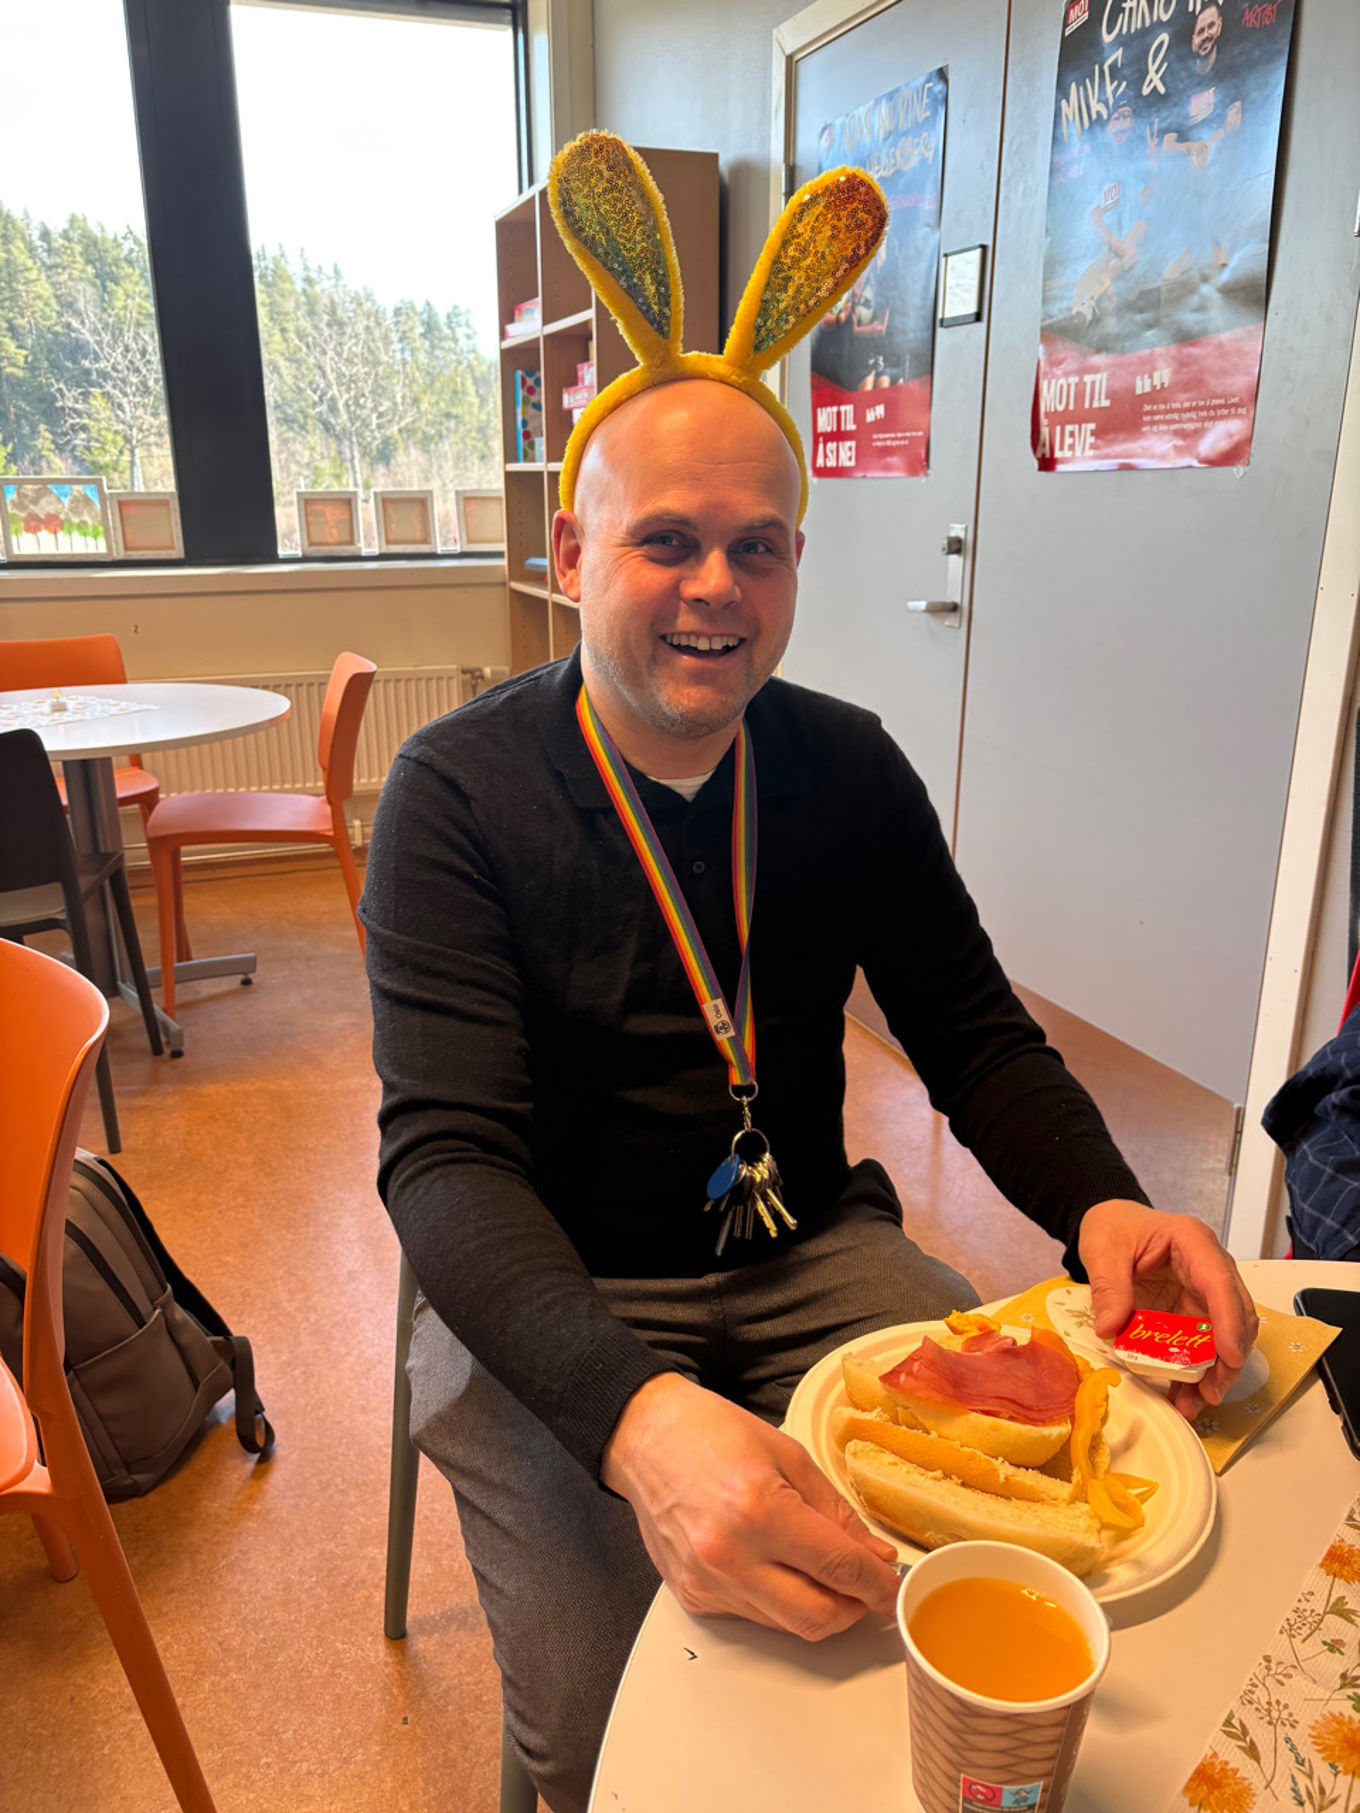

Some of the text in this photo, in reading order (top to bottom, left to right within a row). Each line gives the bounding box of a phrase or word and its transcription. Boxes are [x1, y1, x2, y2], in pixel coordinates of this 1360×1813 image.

[1061, 47, 1127, 142] MIKE
[1141, 32, 1170, 97] &
[1041, 372, 1111, 413] MOT TIL
[816, 404, 857, 433] MOT TIL
[816, 437, 857, 468] Å SI NEI
[1036, 418, 1097, 458] Å LEVE
[1129, 1323, 1212, 1349] brelett
